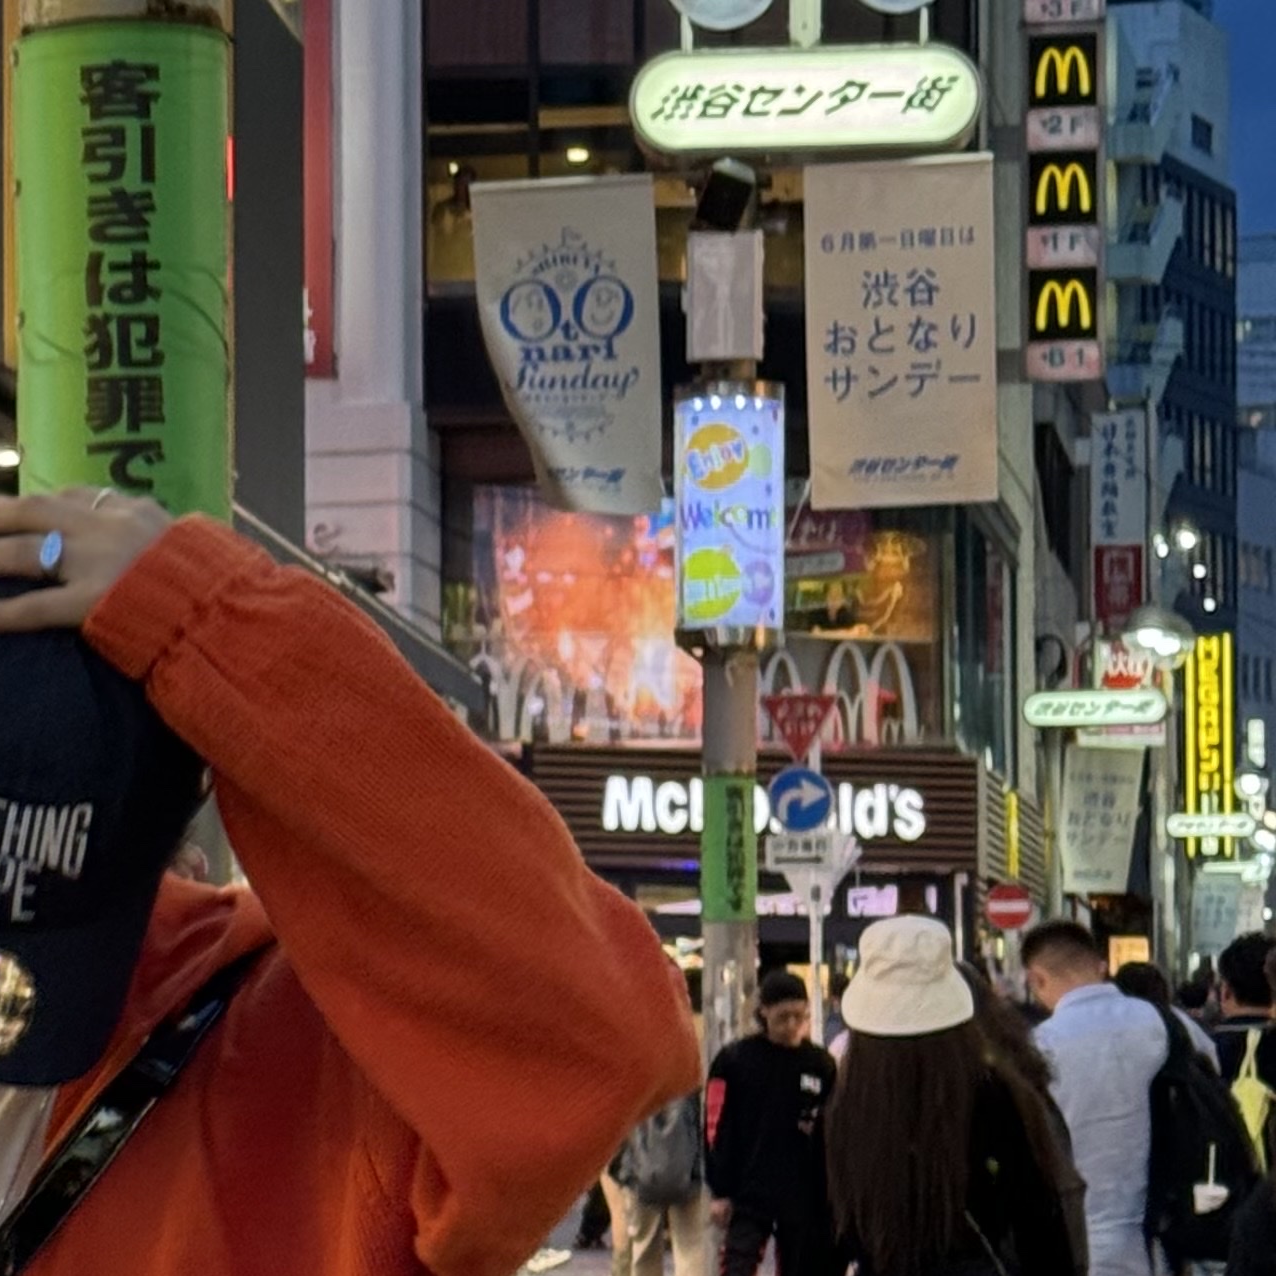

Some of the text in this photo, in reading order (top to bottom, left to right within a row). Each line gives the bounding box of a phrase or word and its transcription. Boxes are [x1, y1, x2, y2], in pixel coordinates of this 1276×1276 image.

[651, 75, 960, 121] 渋谷センター街
[862, 267, 940, 309] 渋谷
[825, 313, 976, 356] おとなり
[824, 358, 981, 404] サンデー
